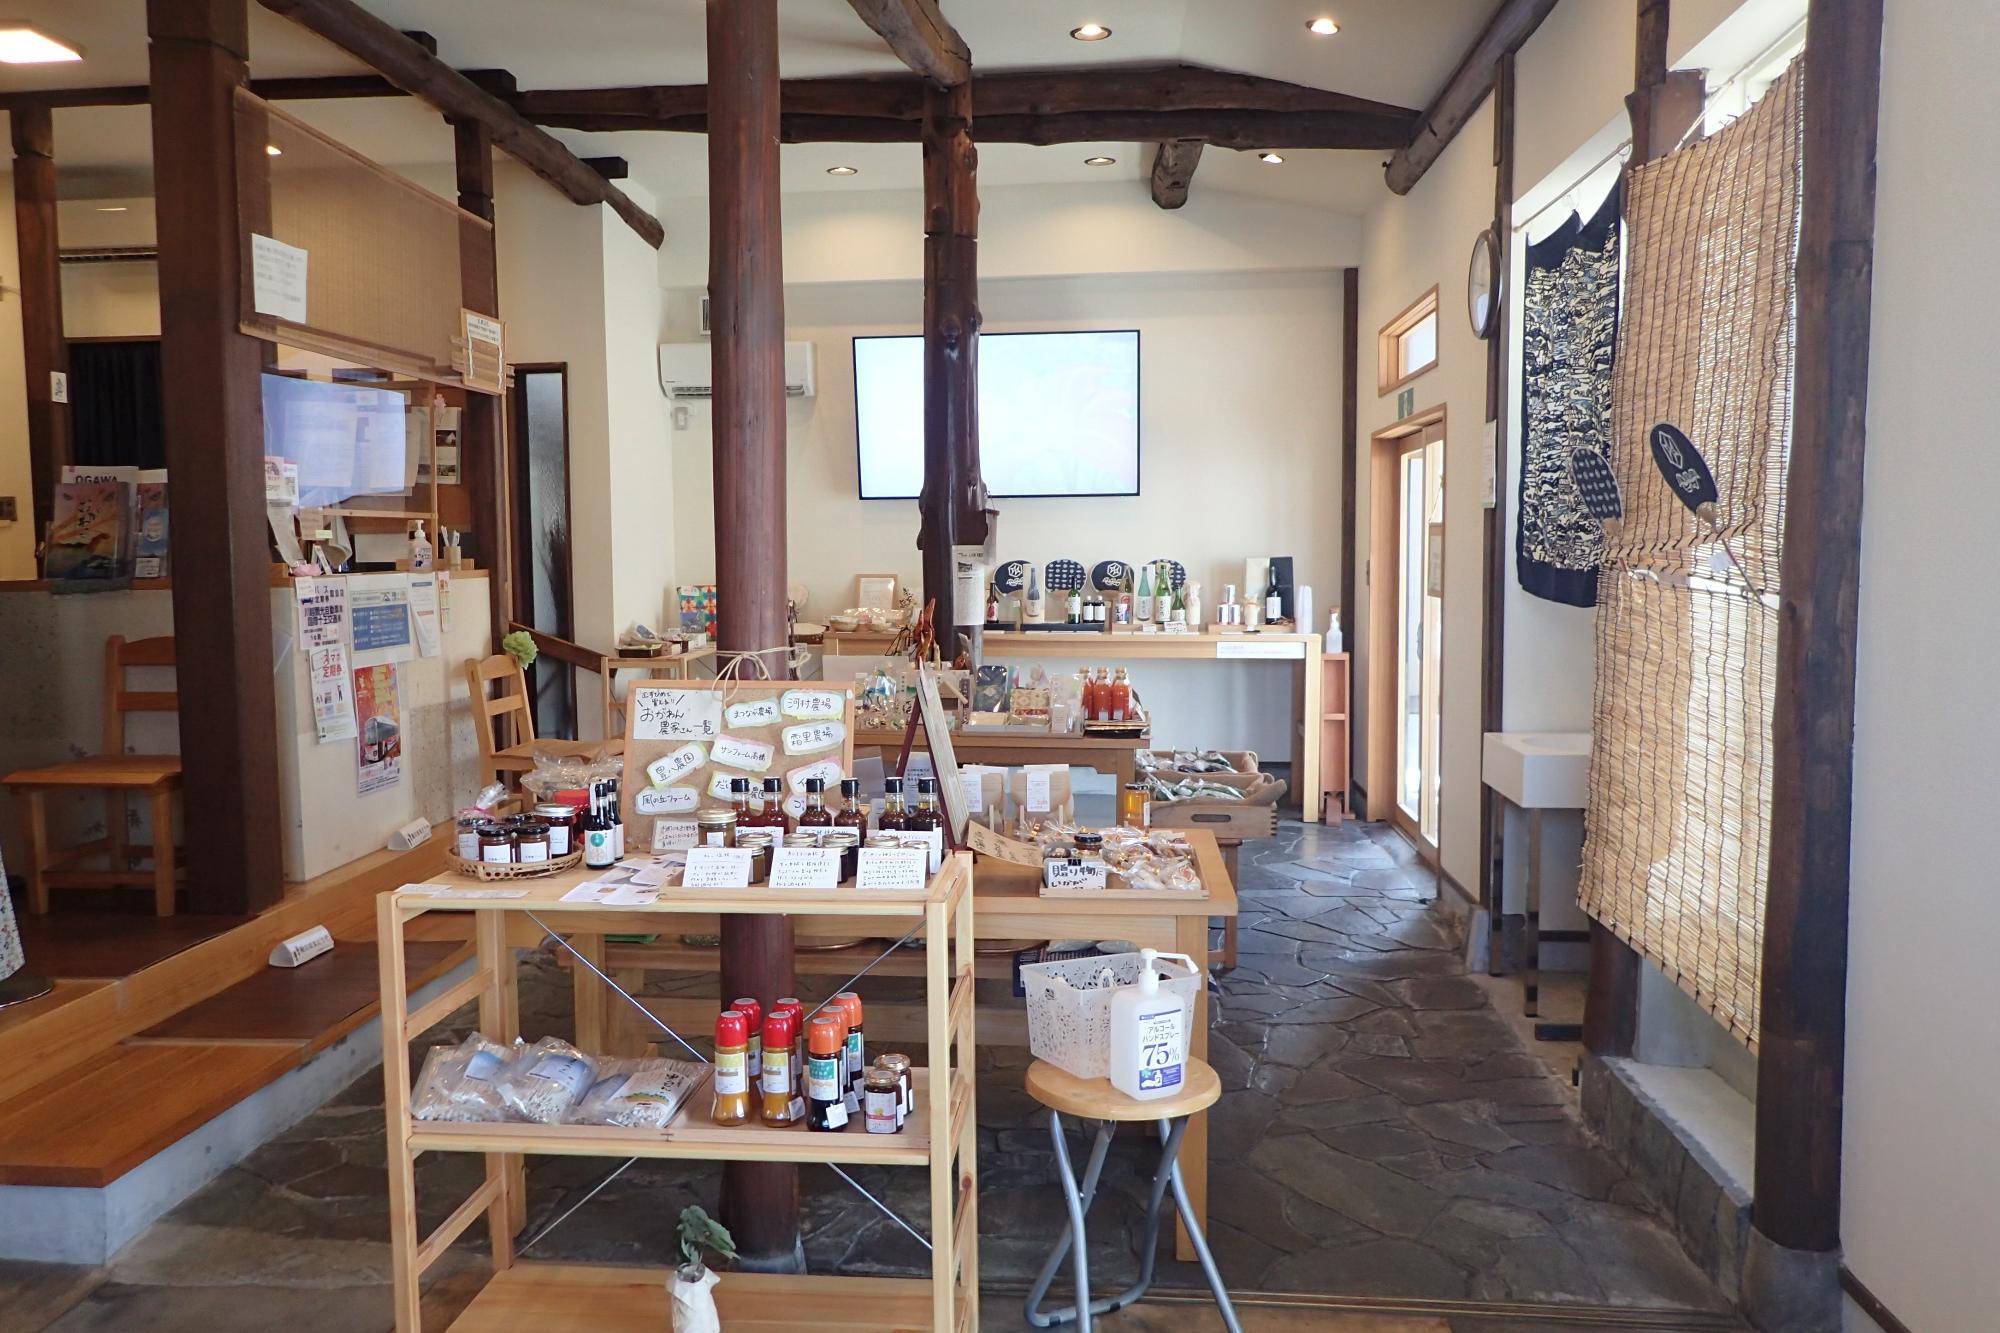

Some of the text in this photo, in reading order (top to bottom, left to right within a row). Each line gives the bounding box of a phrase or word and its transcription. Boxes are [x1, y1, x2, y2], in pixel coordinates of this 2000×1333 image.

[1052, 863, 1103, 877] 贈り物に
[1148, 1023, 1175, 1034] アルコール
[1142, 1032, 1180, 1043] ハンドスプレー
[1142, 1042, 1180, 1066] 75%
